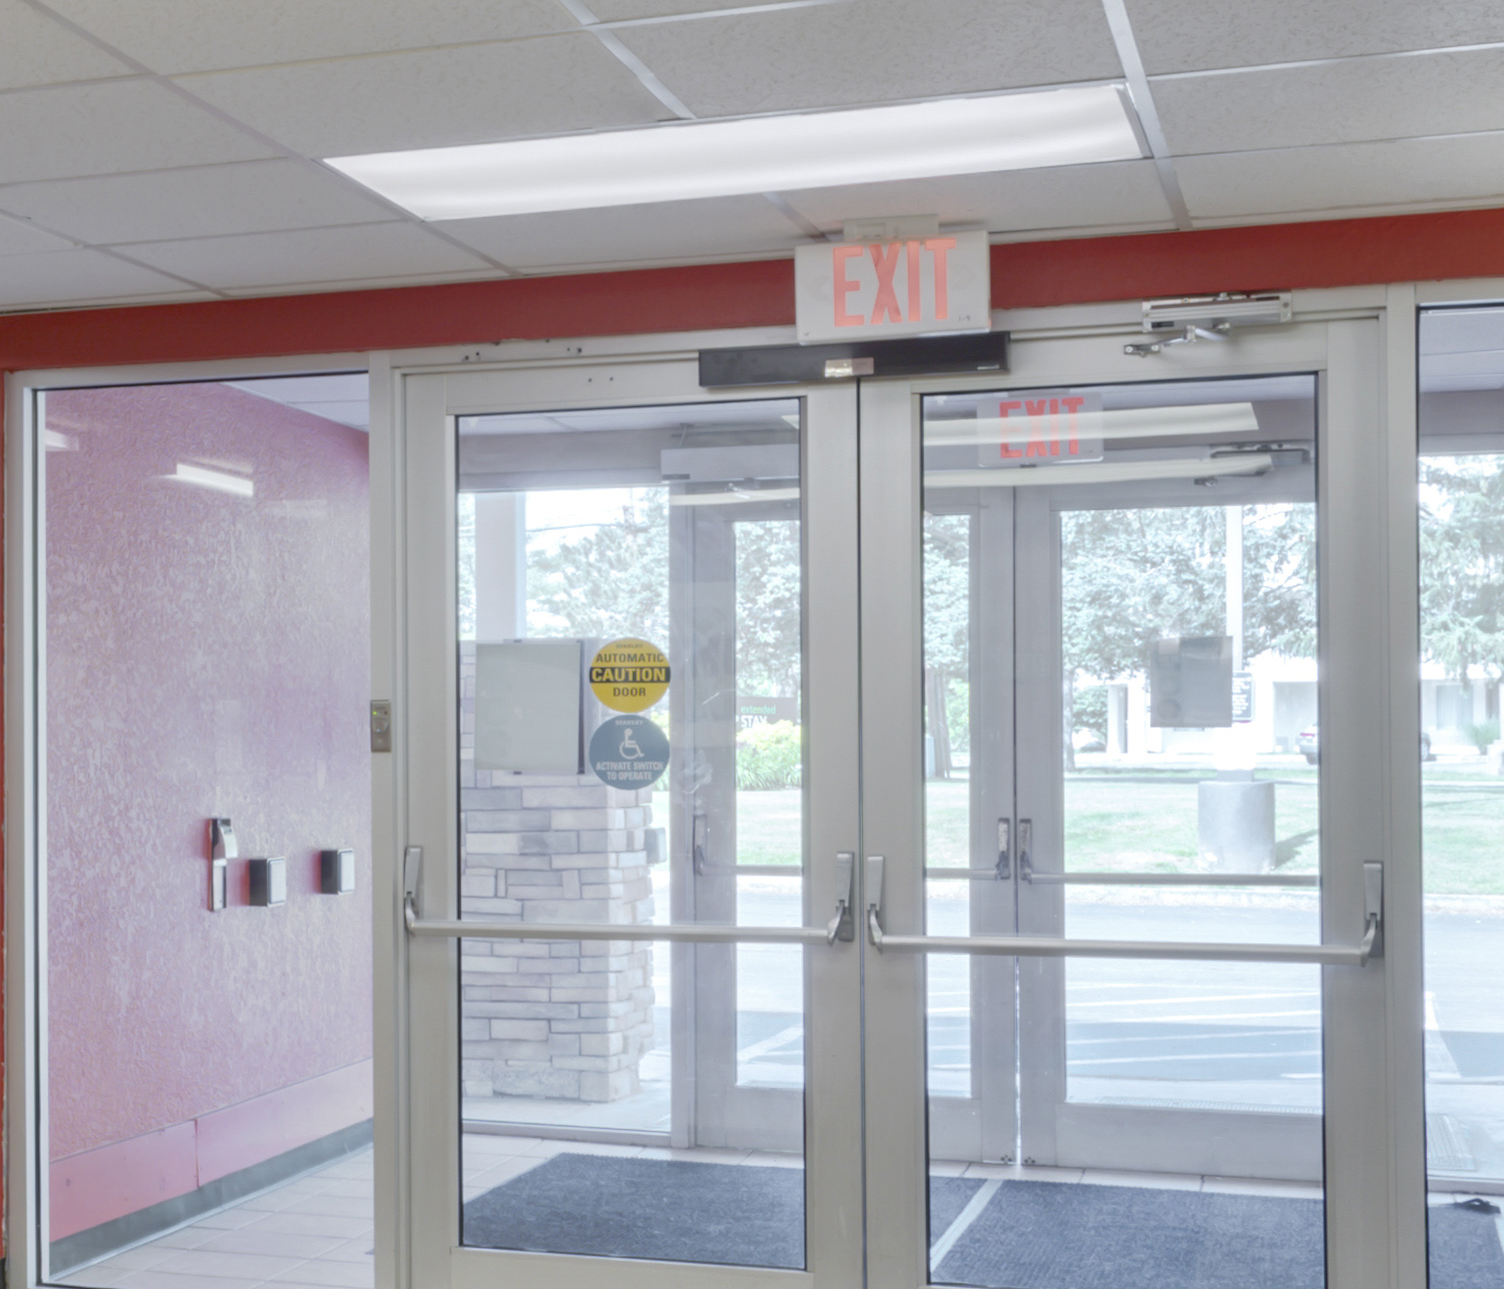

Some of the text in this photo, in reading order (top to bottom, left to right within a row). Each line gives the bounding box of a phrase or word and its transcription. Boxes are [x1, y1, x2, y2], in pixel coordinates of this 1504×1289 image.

[833, 237, 956, 327] EXIT
[999, 397, 1084, 459] EXIT
[596, 653, 664, 663] AUTOMATIC
[592, 667, 666, 682] CAUTION
[613, 687, 647, 697] DOOR
[740, 704, 776, 715] extended
[595, 762, 664, 771] ACTIVATE SWITCH
[606, 771, 652, 781] TO OPERATE
